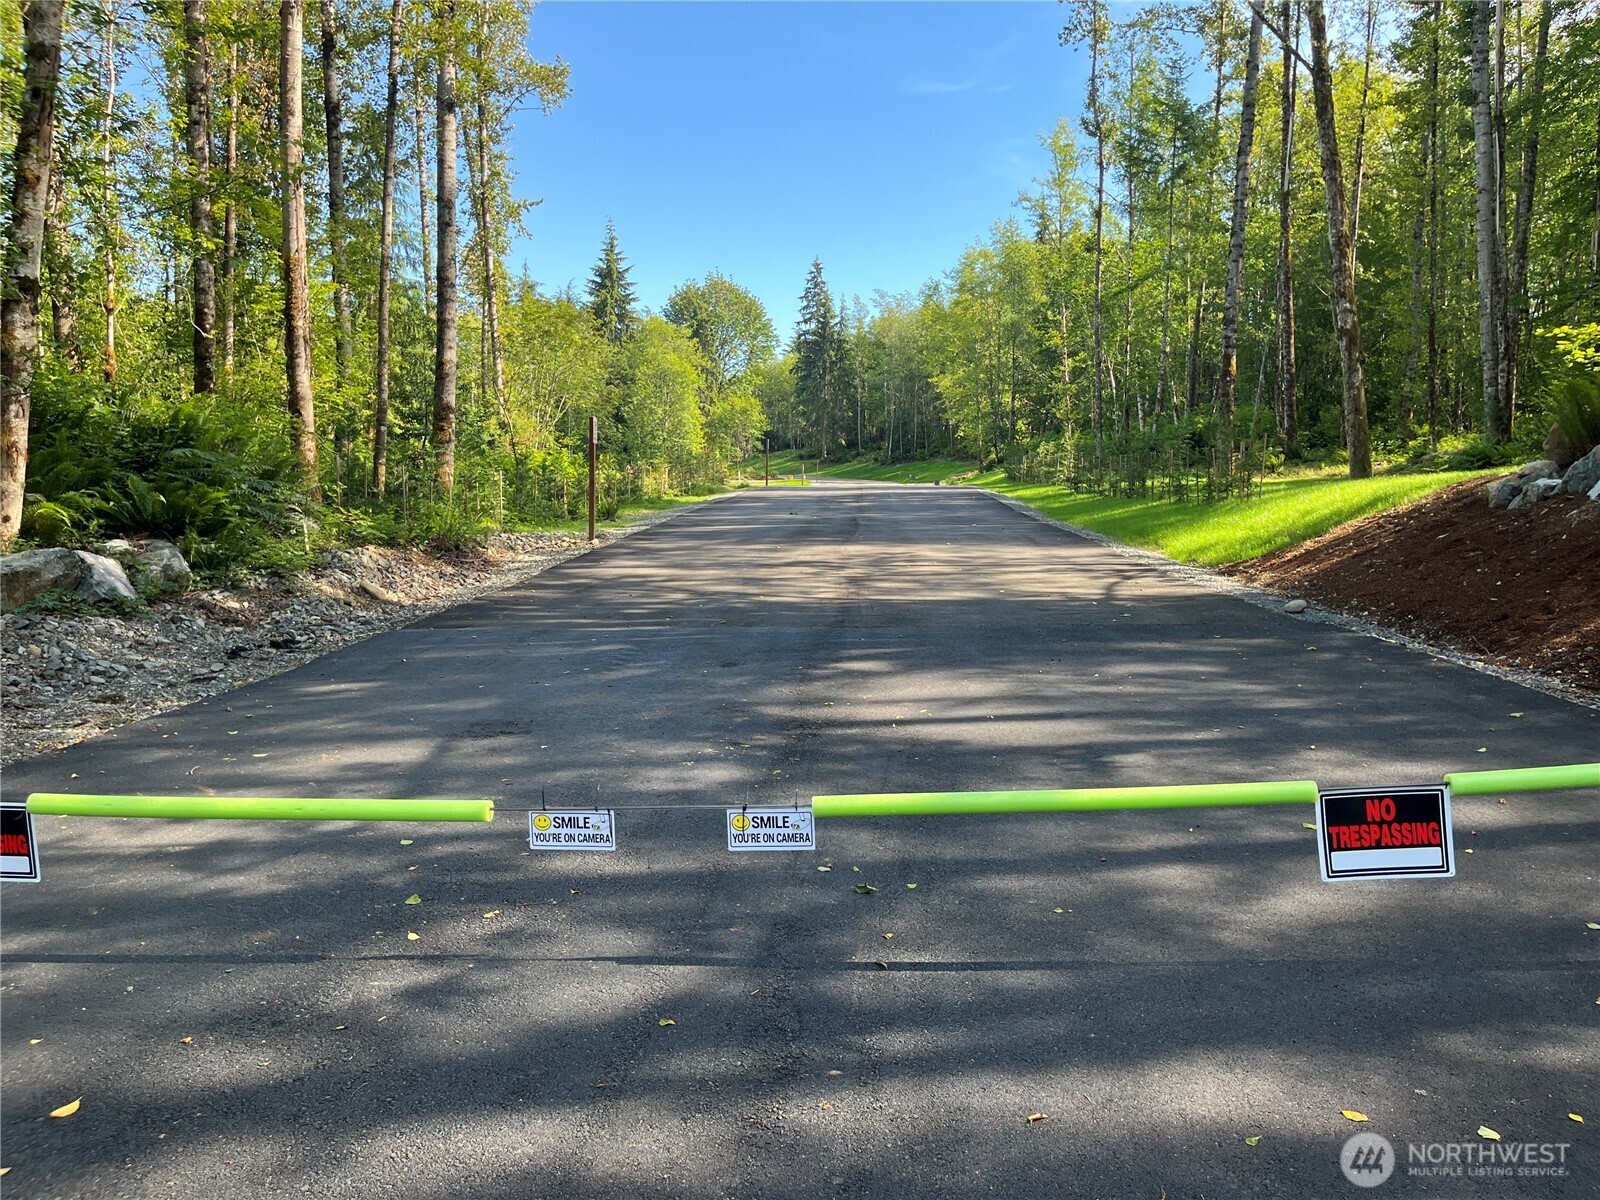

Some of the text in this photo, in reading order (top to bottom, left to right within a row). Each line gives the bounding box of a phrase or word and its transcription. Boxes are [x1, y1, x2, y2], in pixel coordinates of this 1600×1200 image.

[1365, 797, 1396, 822] NO
[552, 816, 591, 829] SMILE
[751, 816, 790, 829] SMILE
[534, 832, 611, 844] YOU'RE ON CAMERA
[732, 832, 811, 843] YOU'RE ON CAMERA
[1328, 822, 1441, 849] TRESPASSING
